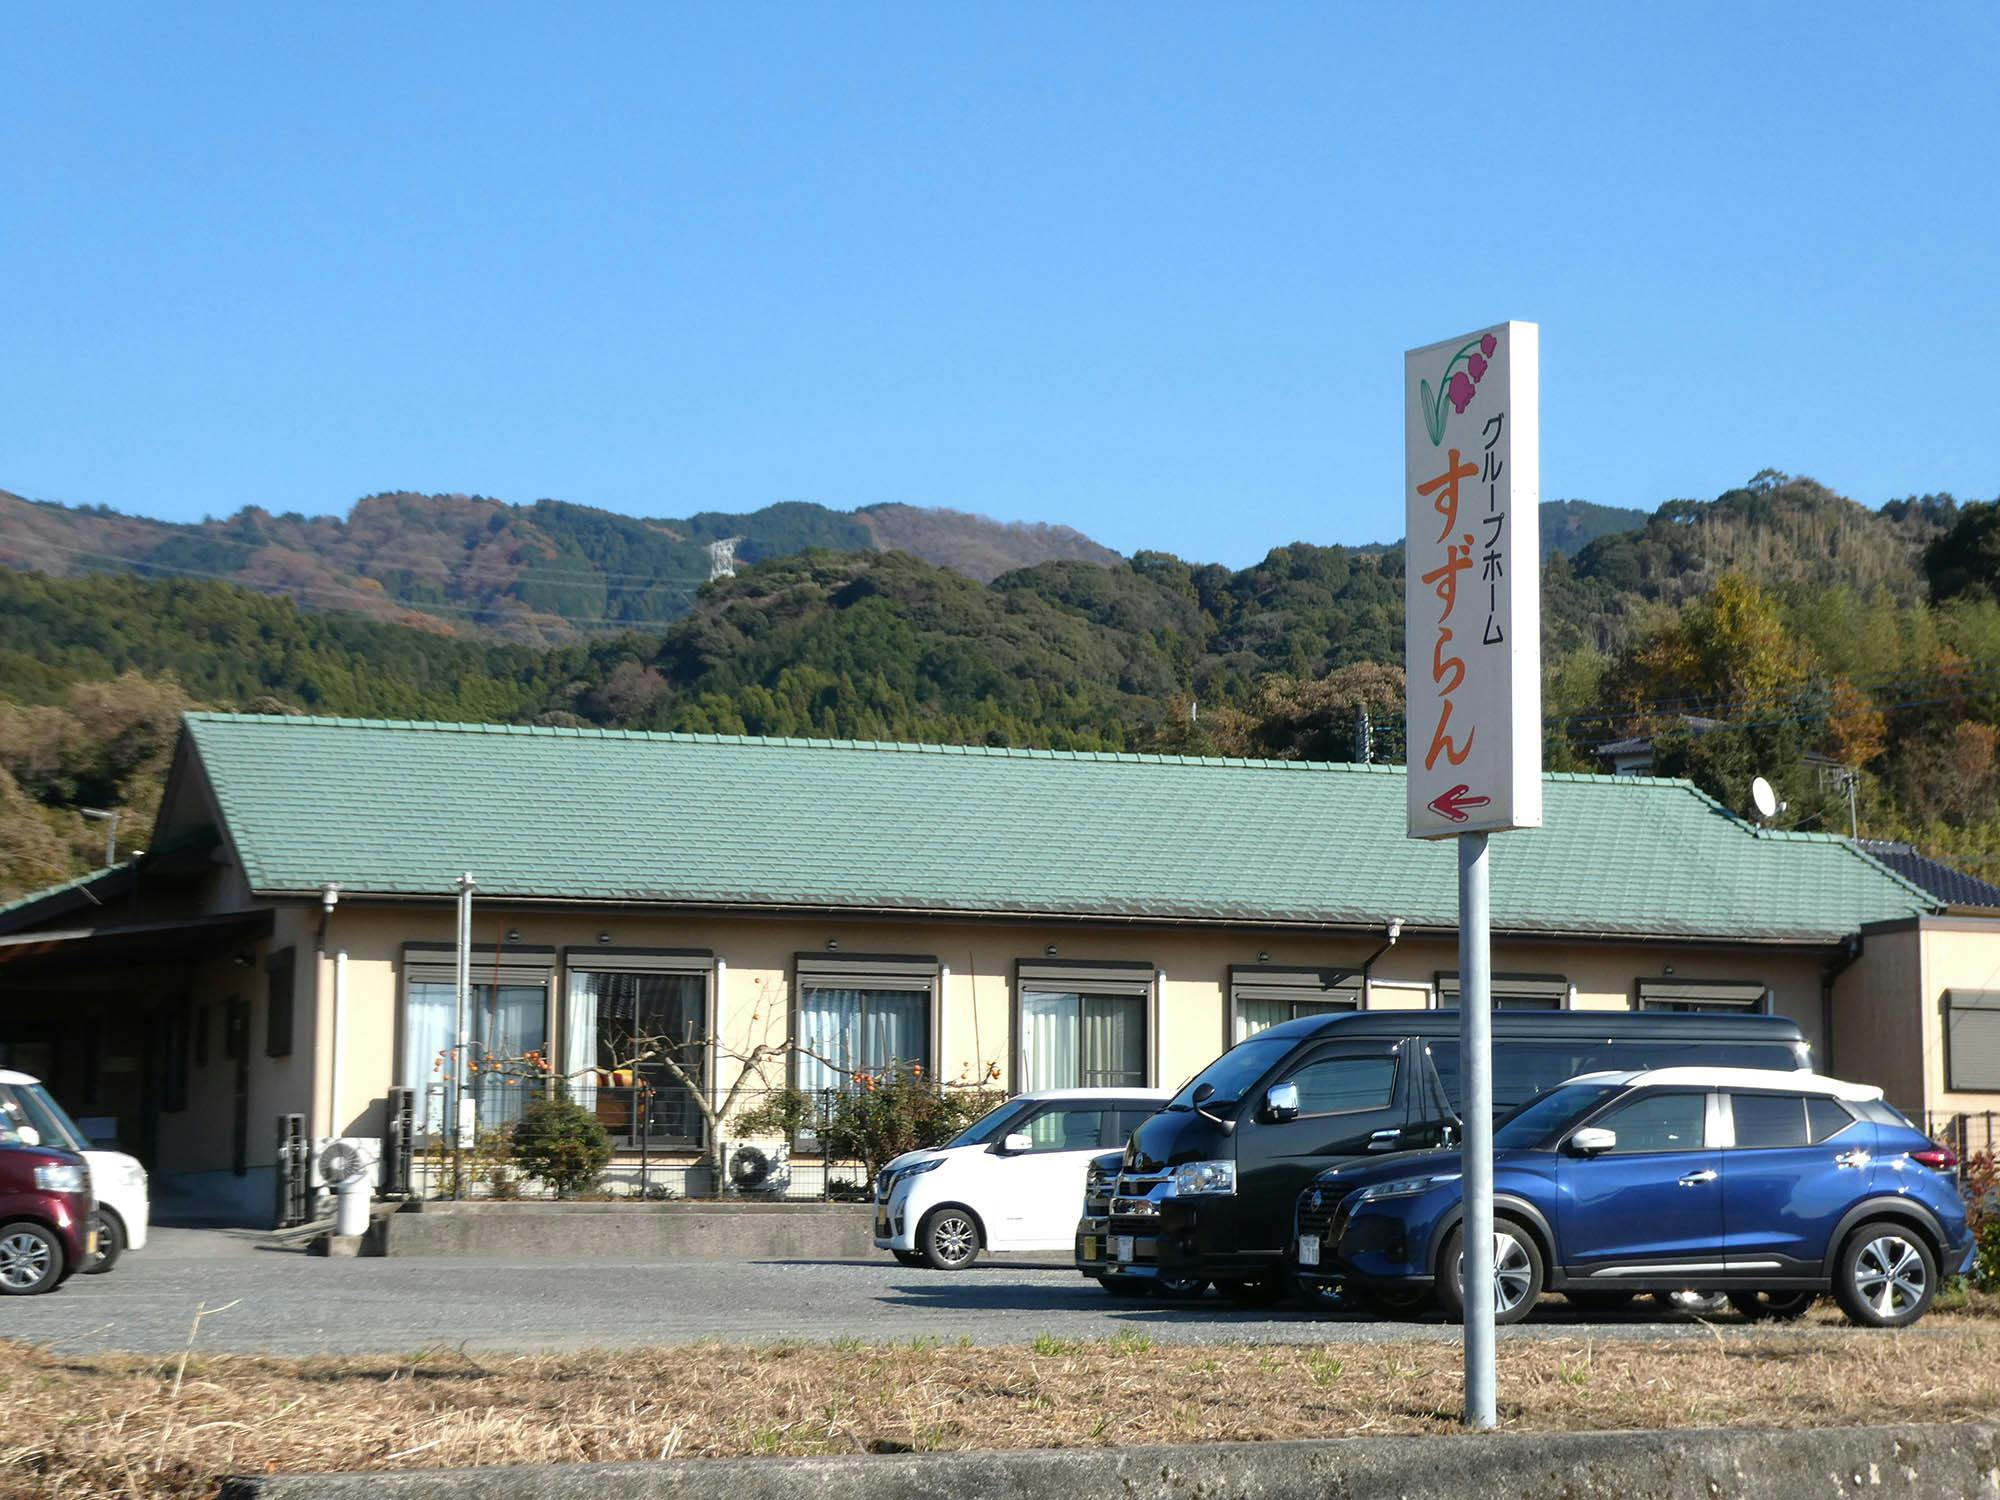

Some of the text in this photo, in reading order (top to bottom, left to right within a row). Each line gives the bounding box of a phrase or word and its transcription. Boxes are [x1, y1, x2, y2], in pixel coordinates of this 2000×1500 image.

[1416, 448, 1479, 771] すずらん
[1481, 411, 1505, 645] グループホーム
